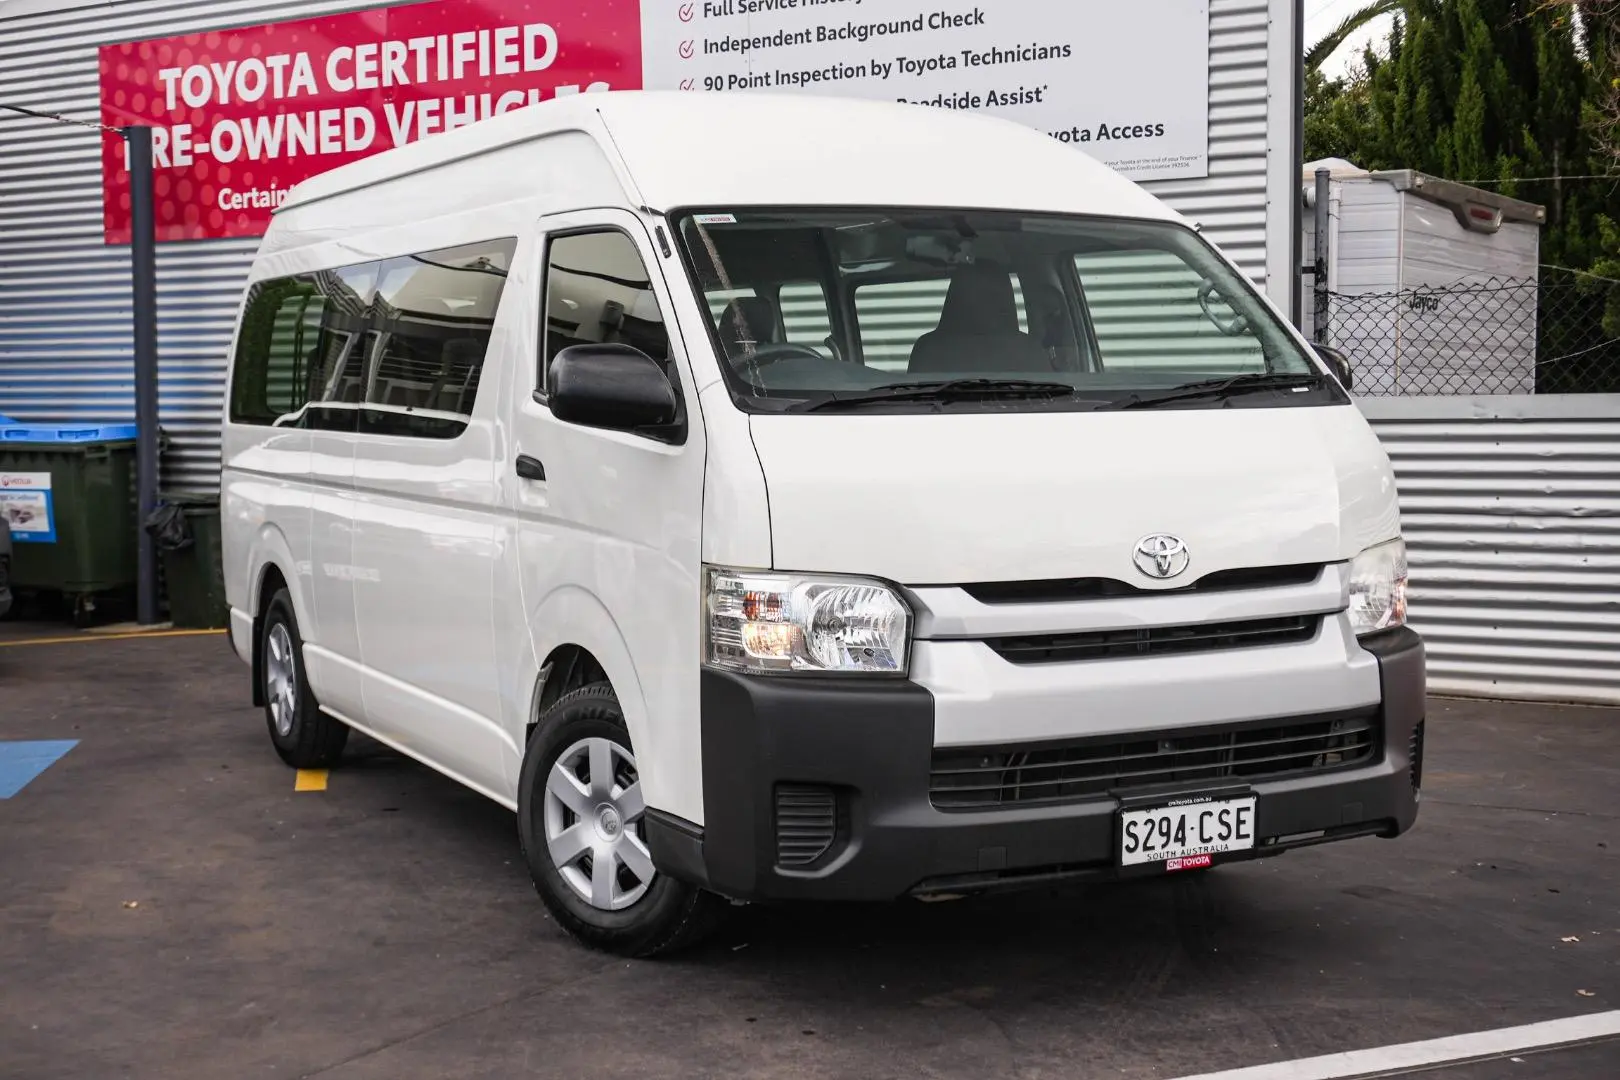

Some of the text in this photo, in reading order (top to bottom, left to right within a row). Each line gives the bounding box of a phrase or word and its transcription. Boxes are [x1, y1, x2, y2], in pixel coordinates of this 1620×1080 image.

[704, 0, 734, 18] Full
[738, 0, 797, 14] Service
[704, 8, 985, 54] Independent Background Check
[159, 23, 559, 111] TOYOTA CERTIFIED
[704, 42, 1072, 91] 90 Point Inspection by Toyota Technicians
[1096, 123, 1165, 140] Access
[1409, 292, 1440, 314] Jayco
[1147, 843, 1230, 862] SOUTH AUSTRALIA
[1183, 855, 1210, 867] TOYOTA
